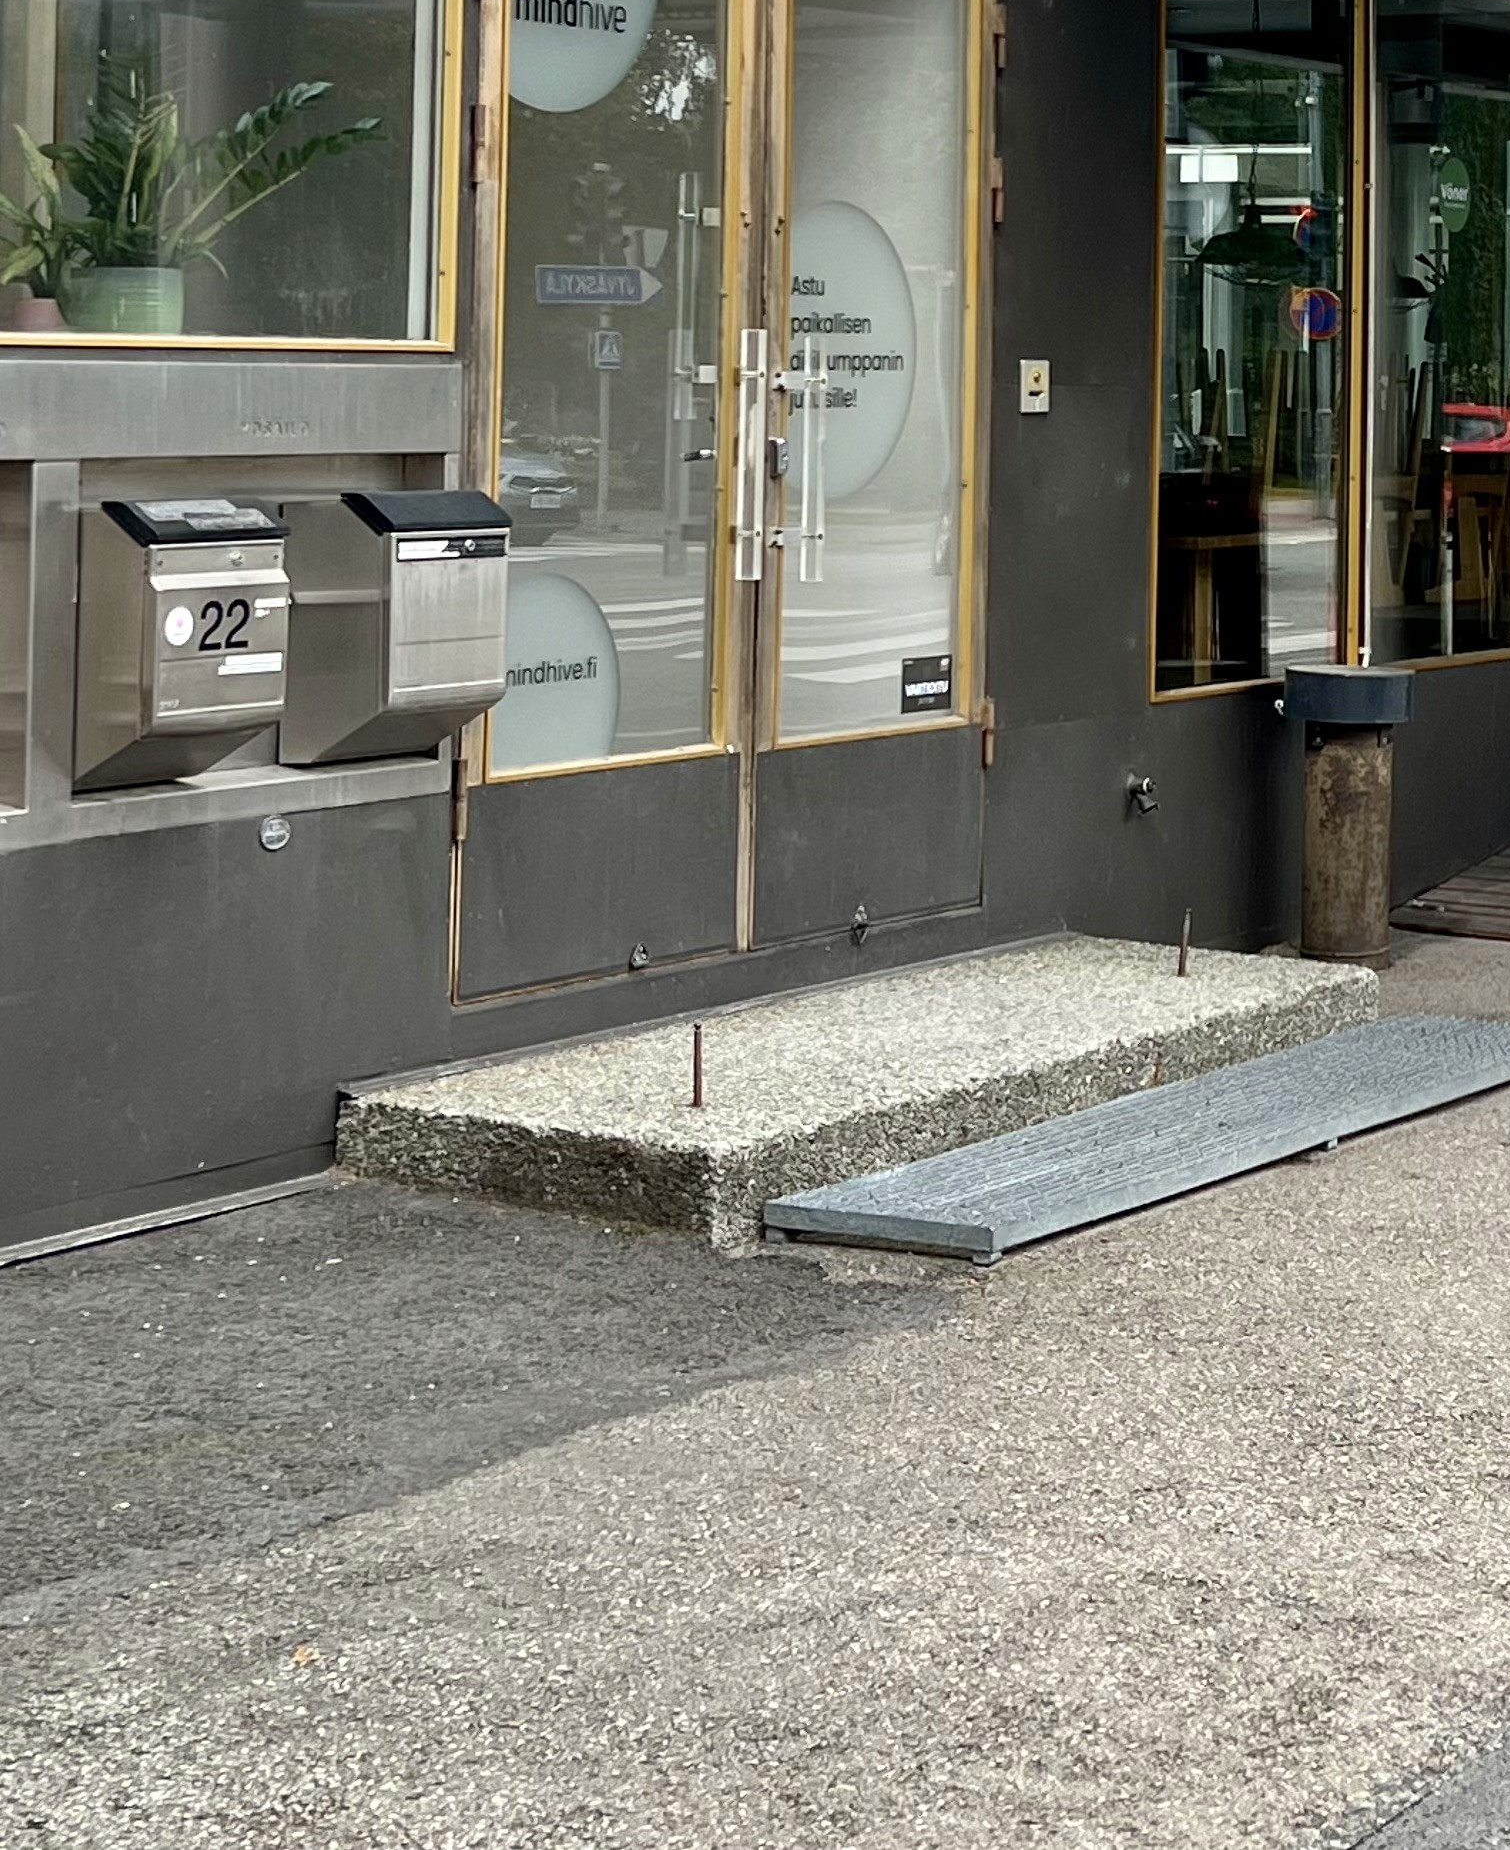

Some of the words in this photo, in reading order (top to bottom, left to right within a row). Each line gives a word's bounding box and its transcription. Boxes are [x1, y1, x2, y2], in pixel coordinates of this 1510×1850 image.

[791, 276, 825, 296] Astu
[790, 312, 872, 340] paikallisen
[199, 599, 249, 651] 22
